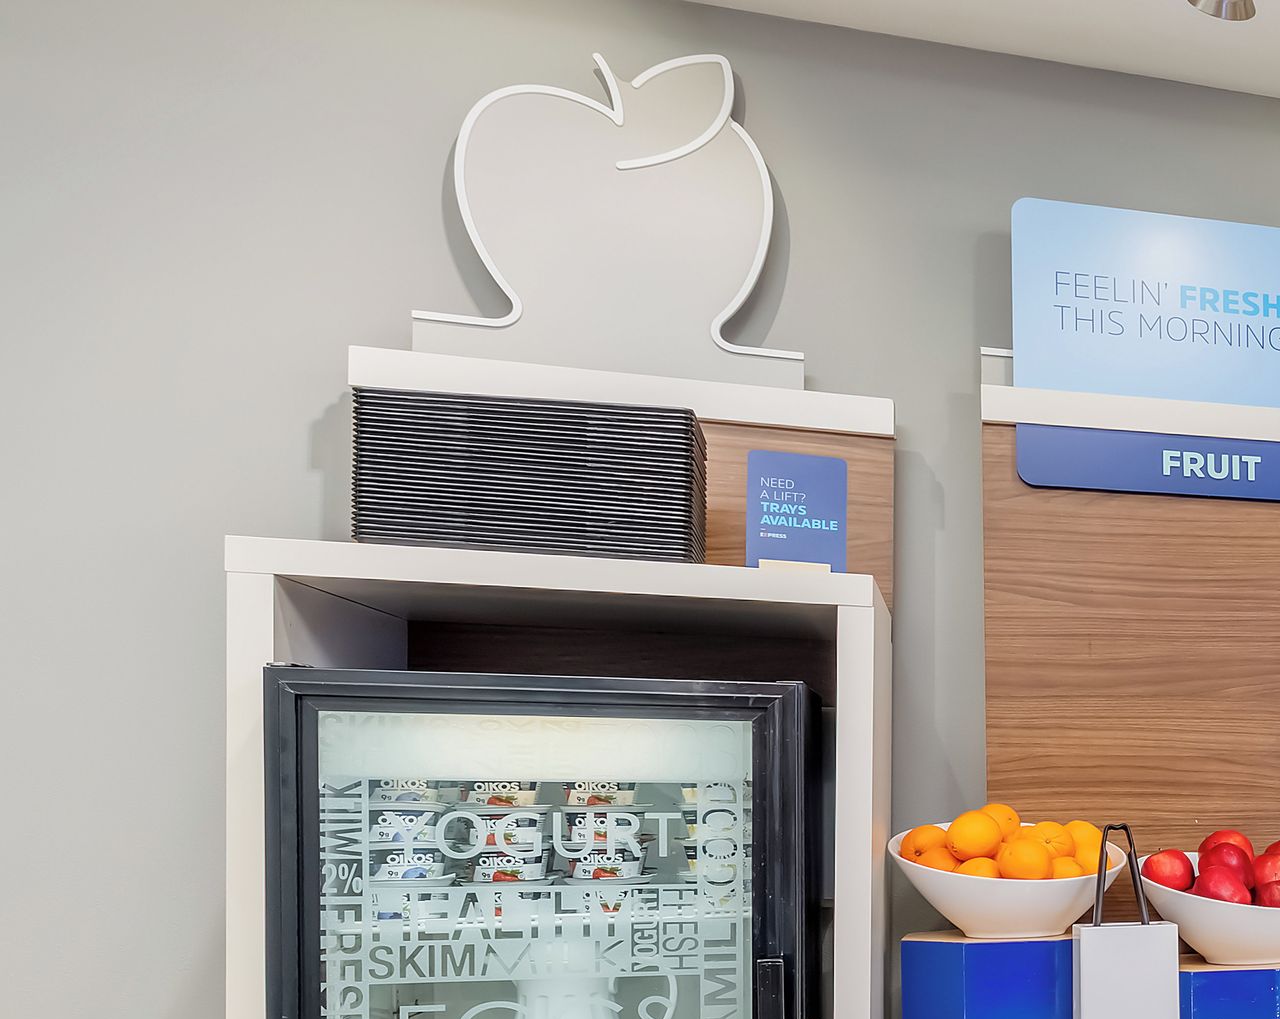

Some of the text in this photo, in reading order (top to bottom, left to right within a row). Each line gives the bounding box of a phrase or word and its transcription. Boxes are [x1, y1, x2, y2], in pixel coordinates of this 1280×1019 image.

[1054, 270, 1168, 306] FEELIN'
[1053, 303, 1125, 336] THIS
[1161, 448, 1262, 482] FRUIT
[760, 476, 795, 490] NEED
[760, 489, 807, 503] A LIFT?
[760, 501, 807, 516] TRAYS
[760, 514, 839, 531] AVAILABLE
[380, 779, 427, 789] OIKOS
[473, 781, 520, 791] OIKOS
[574, 781, 619, 791] OIKOS
[321, 780, 363, 856] MILK
[383, 811, 682, 859] YOGURT
[386, 853, 433, 864] OIKOS
[479, 856, 525, 867] OIKOS
[581, 853, 624, 863] OIKOS
[321, 861, 363, 896] 2%
[372, 889, 628, 941] HEALTHY
[631, 888, 660, 973] YOGURT
[662, 888, 699, 971] FRESH
[368, 939, 625, 980] SKIM MILK
